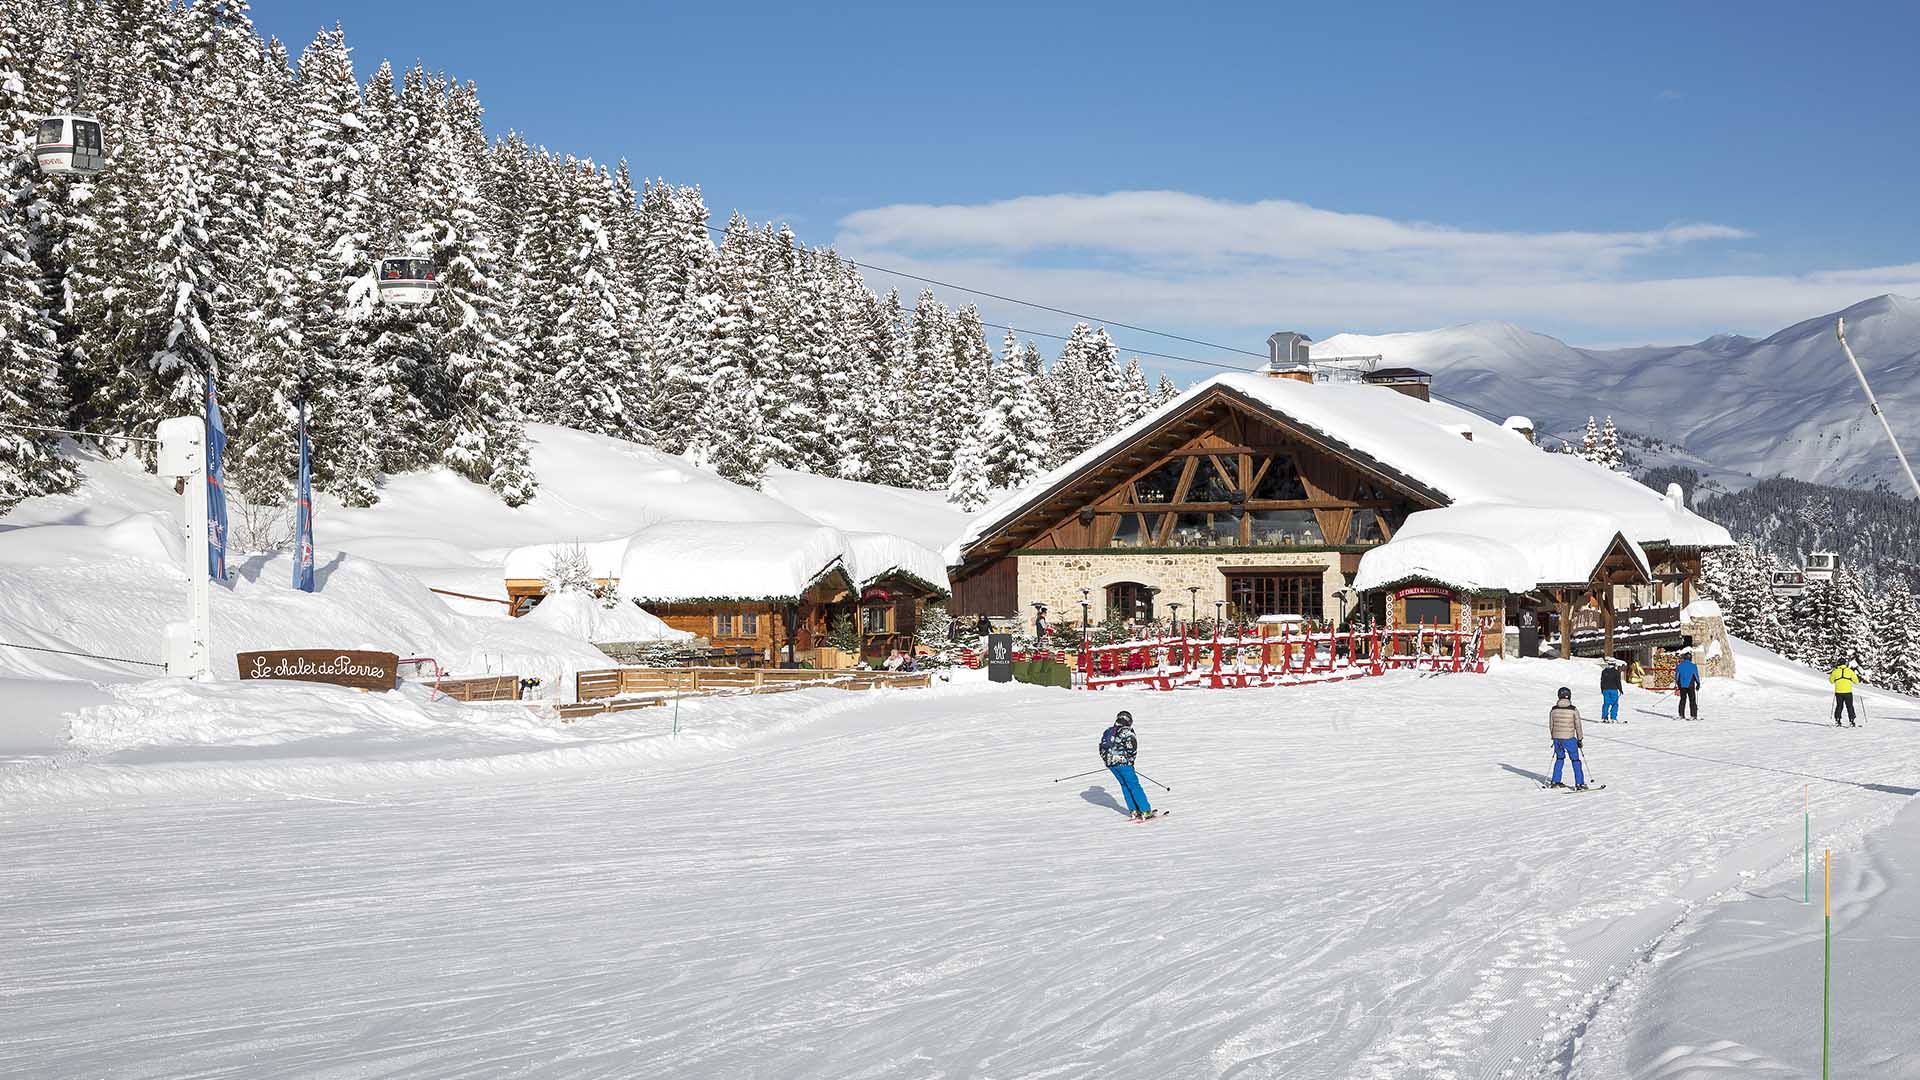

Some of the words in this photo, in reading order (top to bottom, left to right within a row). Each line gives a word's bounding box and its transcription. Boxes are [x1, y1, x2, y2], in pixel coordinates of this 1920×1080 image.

[250, 655, 272, 679] Le
[273, 657, 318, 677] chalet
[318, 661, 334, 675] de
[334, 655, 385, 679] Pierres
